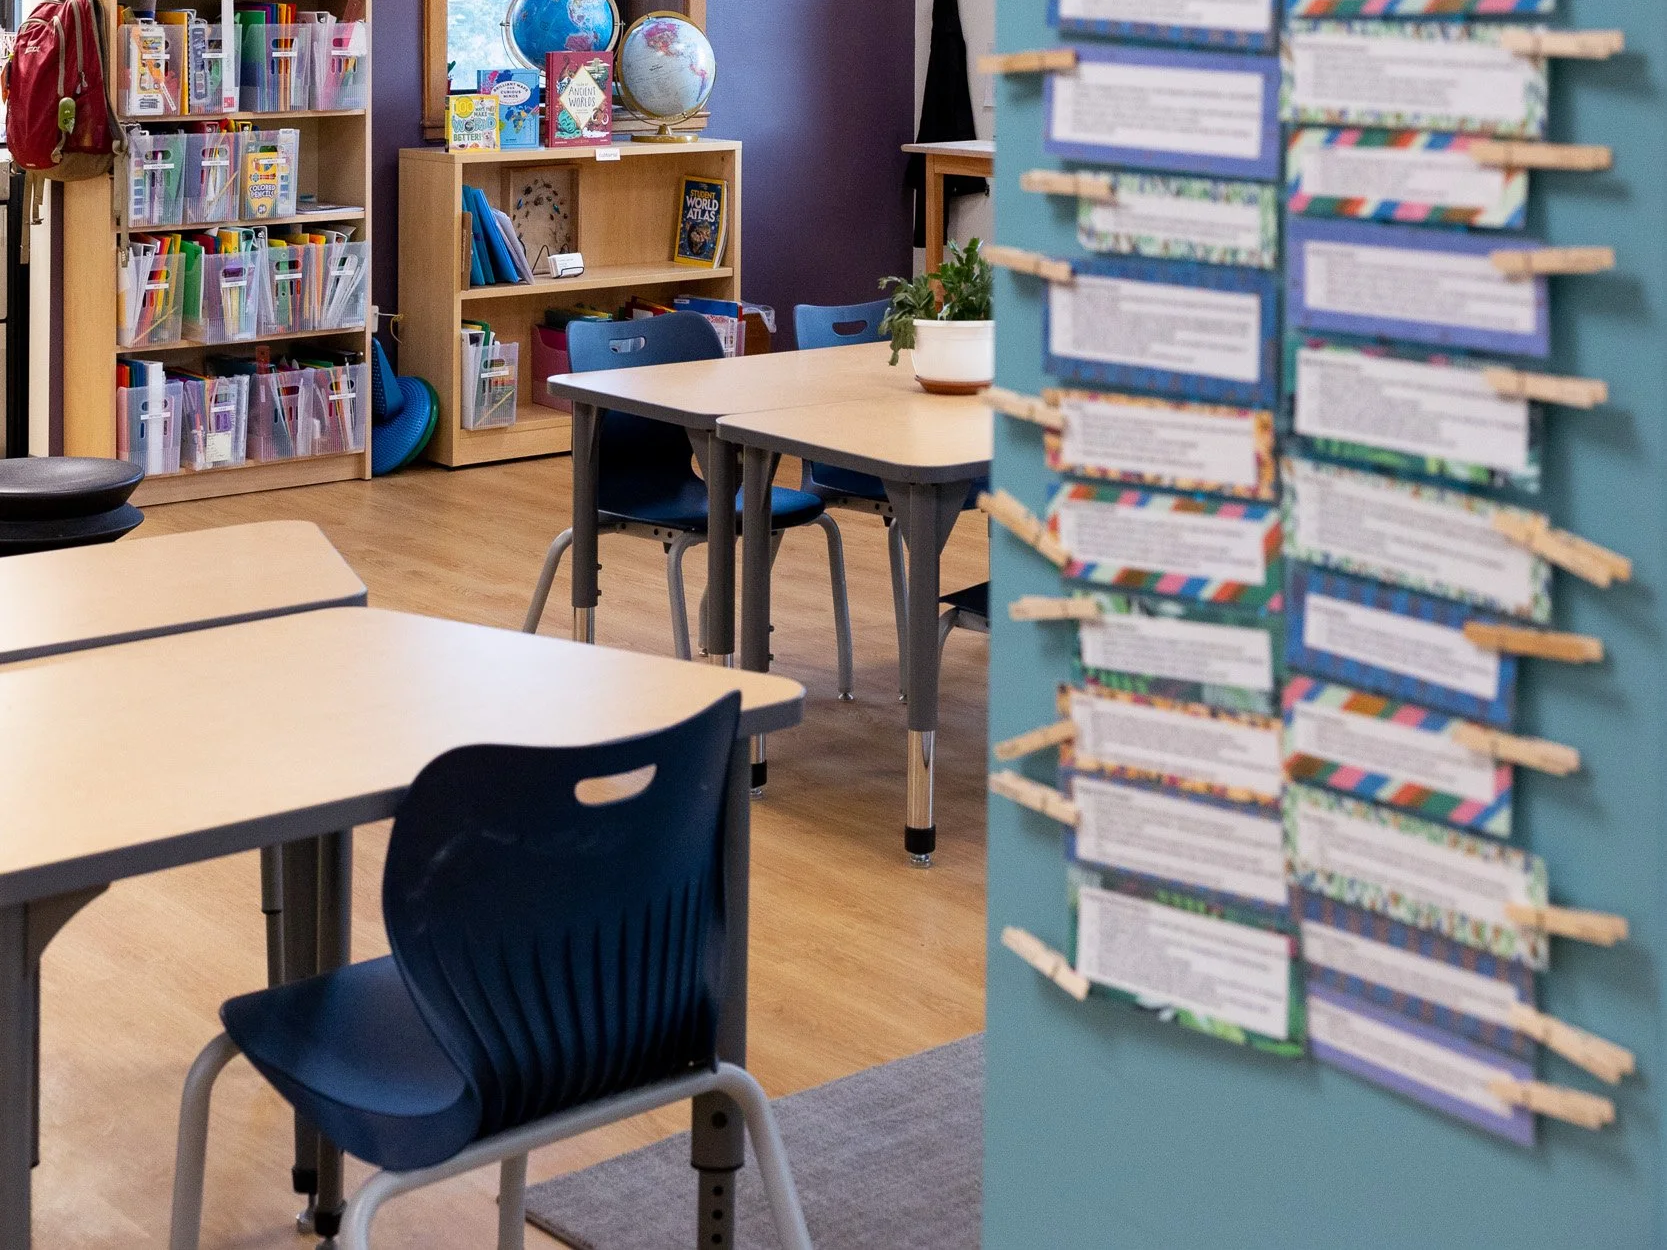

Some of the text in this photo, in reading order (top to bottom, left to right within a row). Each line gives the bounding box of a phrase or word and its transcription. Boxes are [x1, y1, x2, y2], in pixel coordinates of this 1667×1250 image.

[493, 83, 529, 92] BRILLIANT MAPS
[568, 86, 596, 96] ANCIENT
[454, 101, 473, 113] 100
[568, 97, 596, 107] WORLDS
[452, 117, 497, 133] WORLD
[453, 133, 481, 141] BETTER!
[250, 190, 274, 199] PENCILS
[690, 189, 716, 199] STUDENT
[686, 196, 719, 211] WORLD
[687, 208, 716, 223] ATLAS
